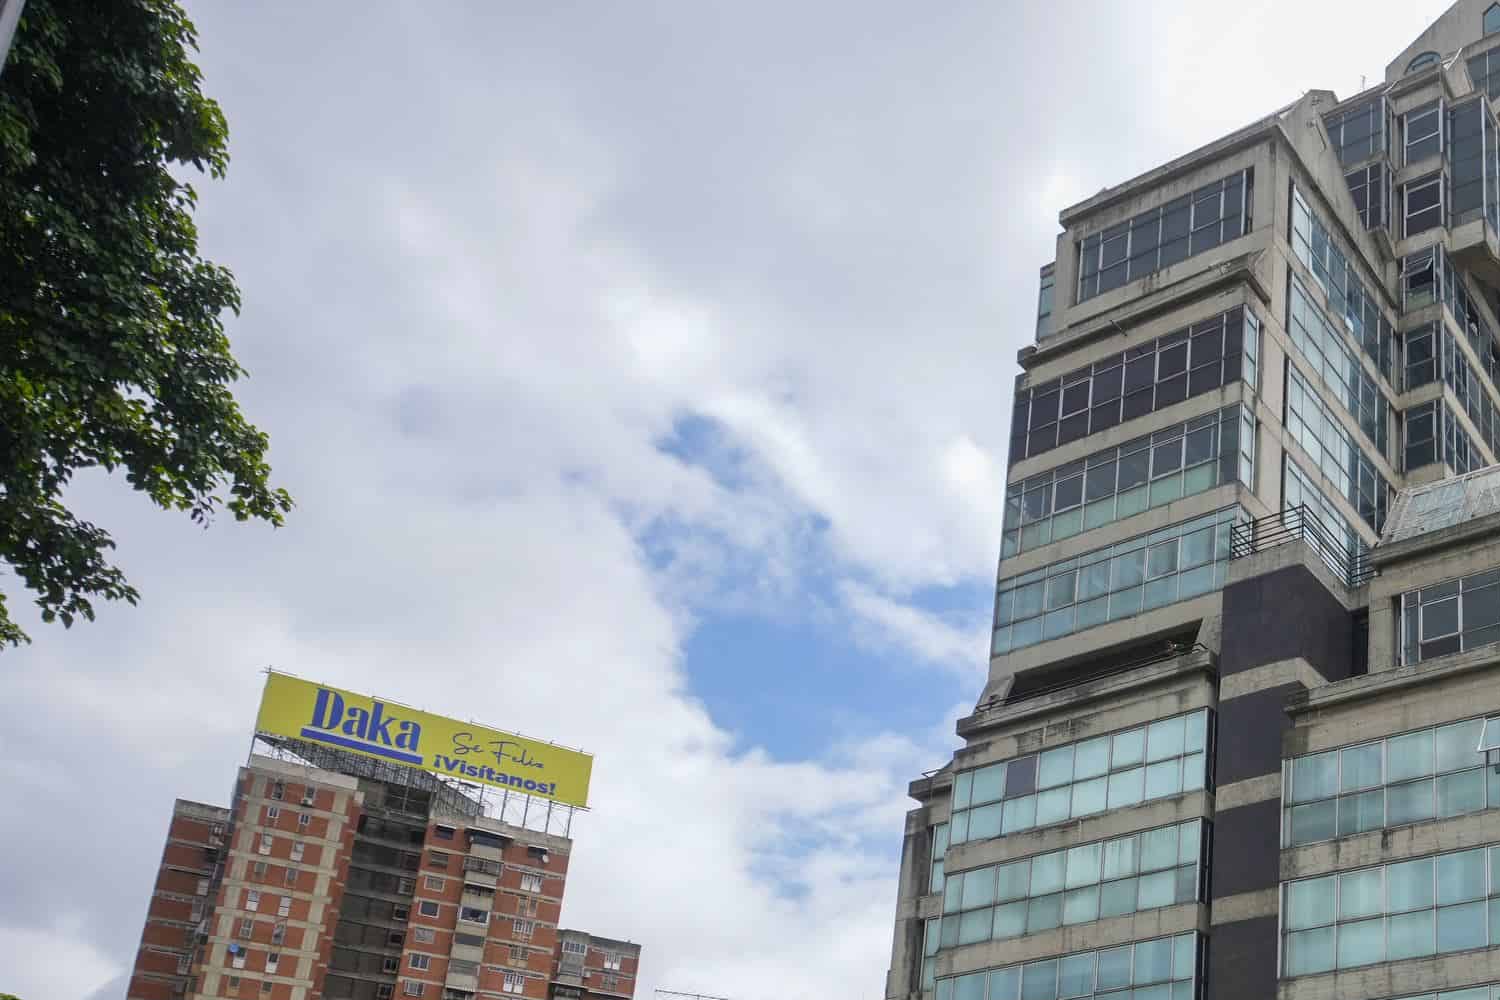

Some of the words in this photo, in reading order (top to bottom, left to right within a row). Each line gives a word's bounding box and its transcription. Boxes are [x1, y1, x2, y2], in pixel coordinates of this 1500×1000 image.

[307, 688, 422, 753] Daka
[452, 732, 484, 756] Se
[433, 755, 556, 796] ¡Visítanos!
